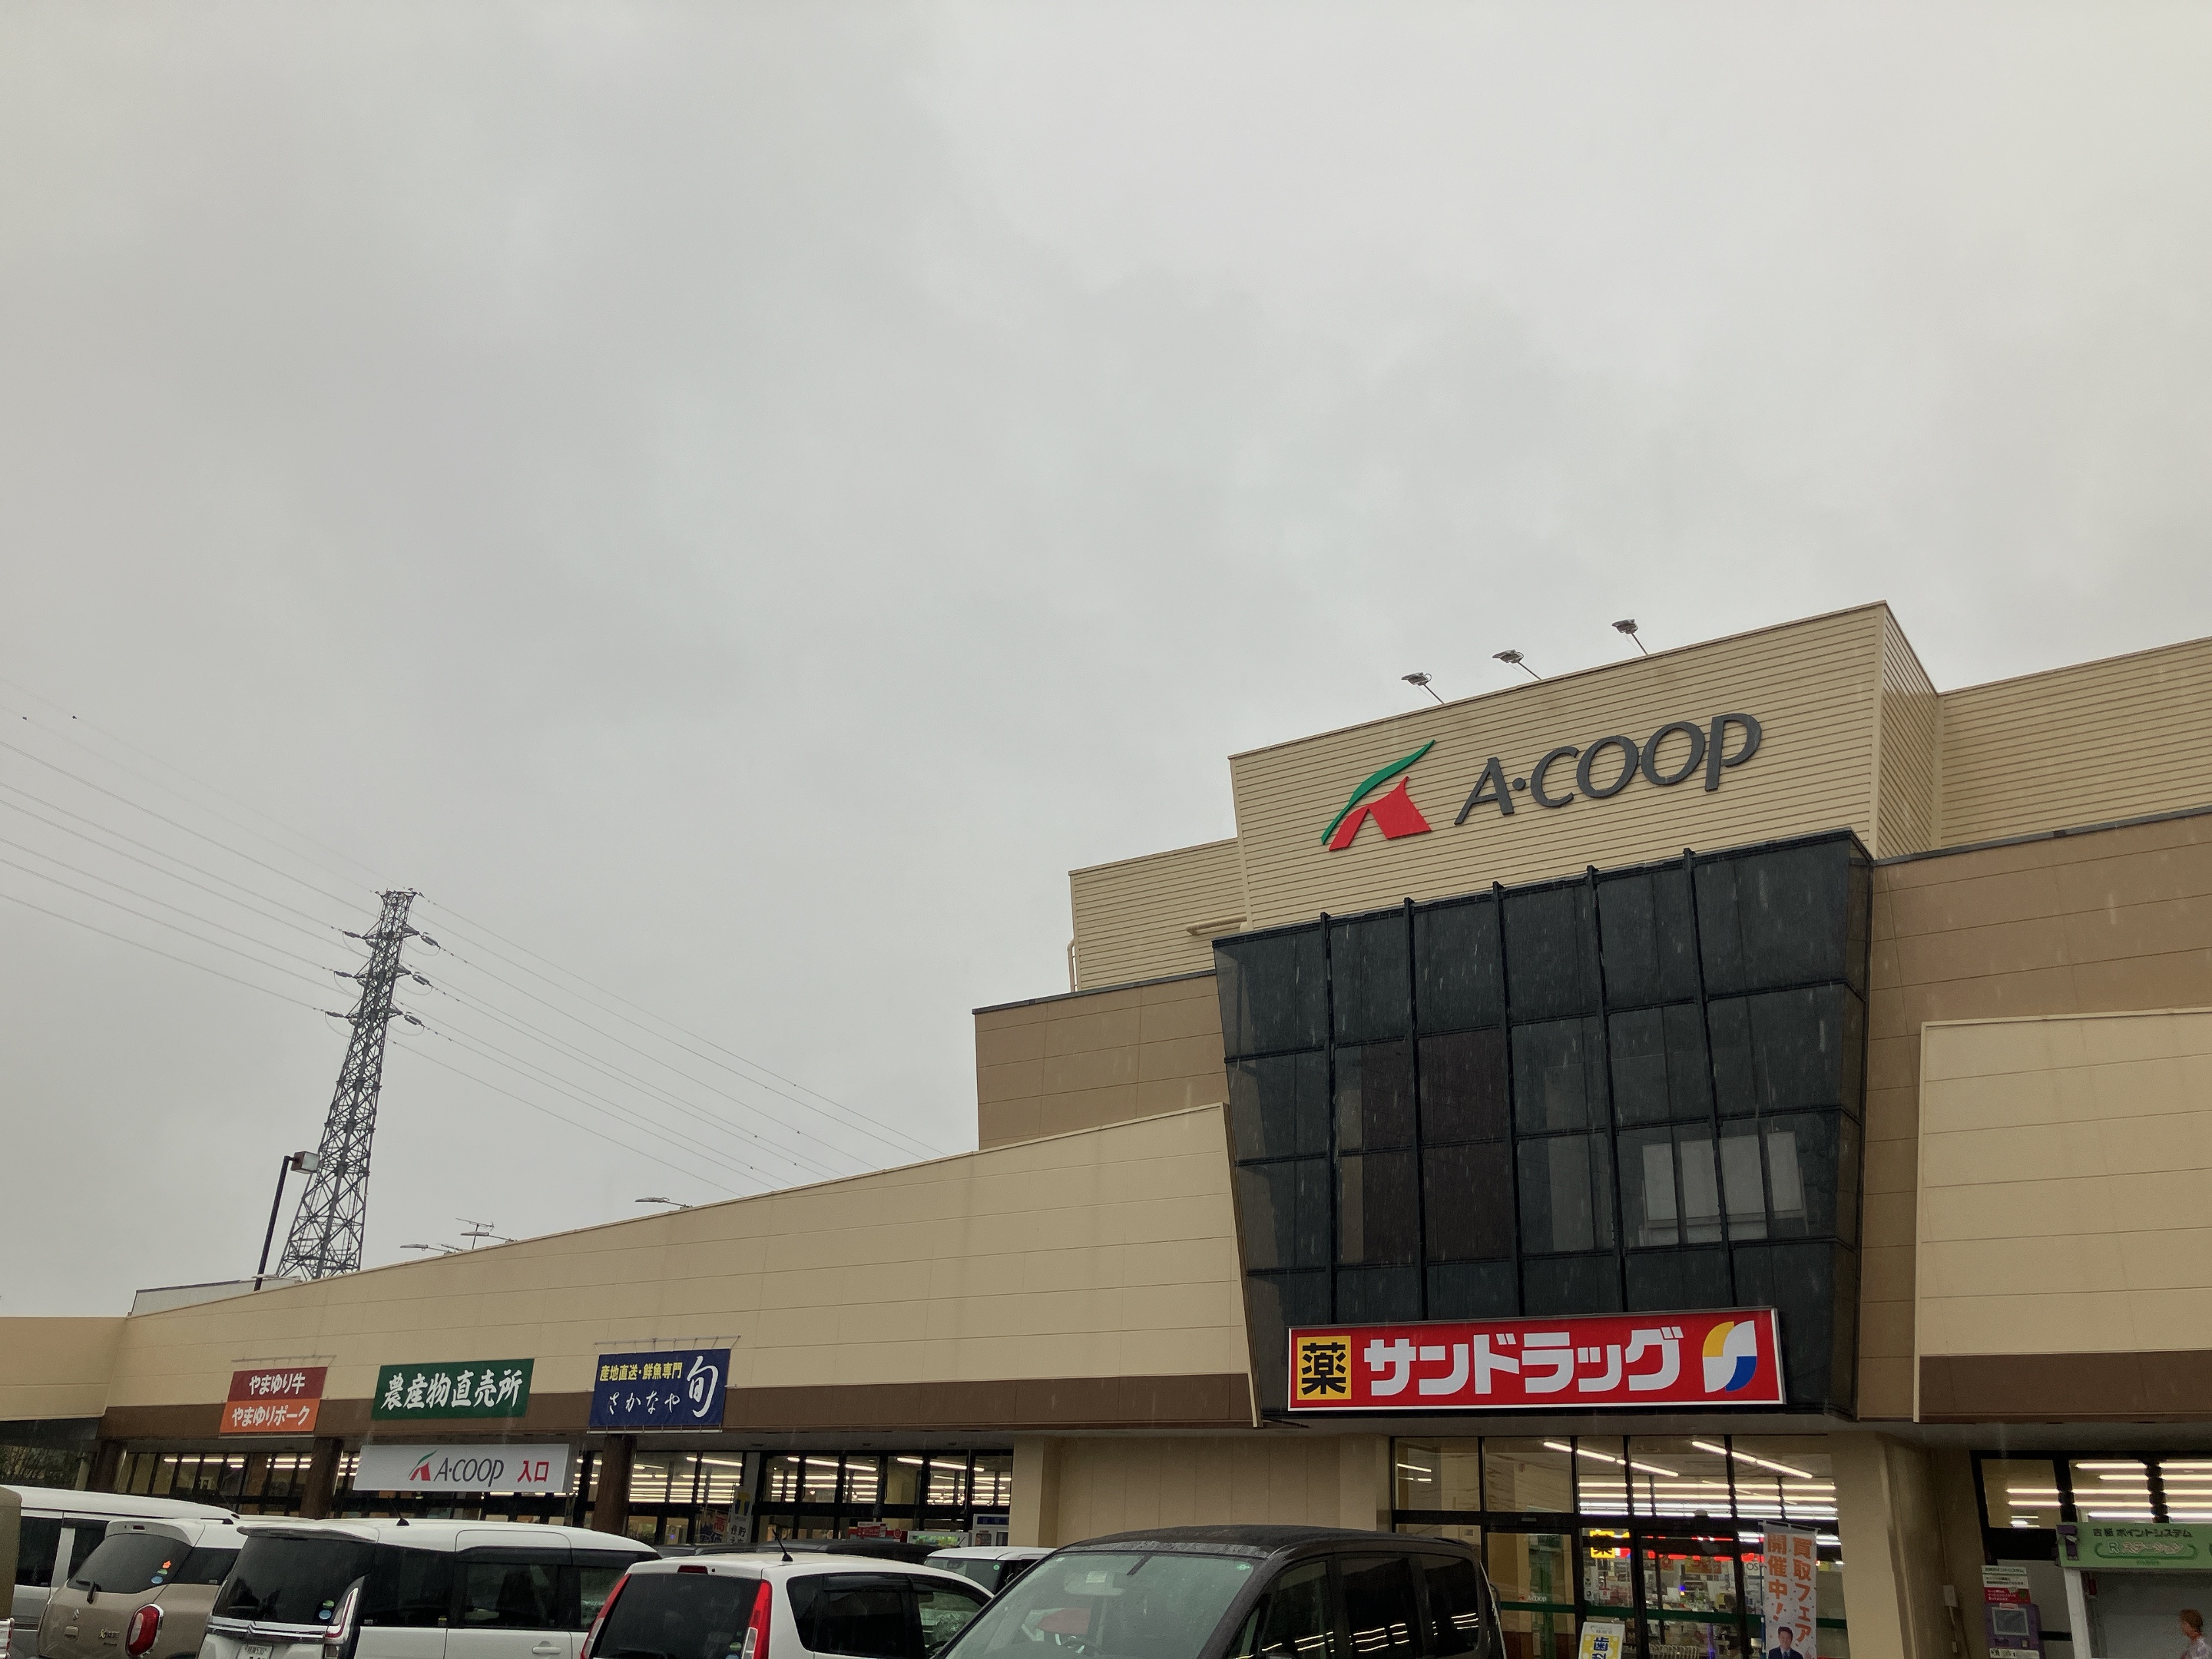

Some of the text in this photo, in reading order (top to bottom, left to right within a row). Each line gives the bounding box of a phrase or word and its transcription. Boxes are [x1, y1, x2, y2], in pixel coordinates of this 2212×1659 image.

[600, 1363, 683, 1382] 産地直送・鮮魚専門
[1301, 1326, 1684, 1396] 薬 サンドラッグ
[249, 1373, 306, 1395] やまゆり牛
[381, 1369, 523, 1411] 農産物直売所
[687, 1355, 719, 1418] 旬
[232, 1404, 310, 1427] やまゆりポーク
[609, 1390, 680, 1415] さかなや
[517, 1460, 550, 1483] 入口
[1767, 1534, 1788, 1621] 開催中！
[1793, 1537, 1813, 1643] 買取フェア
